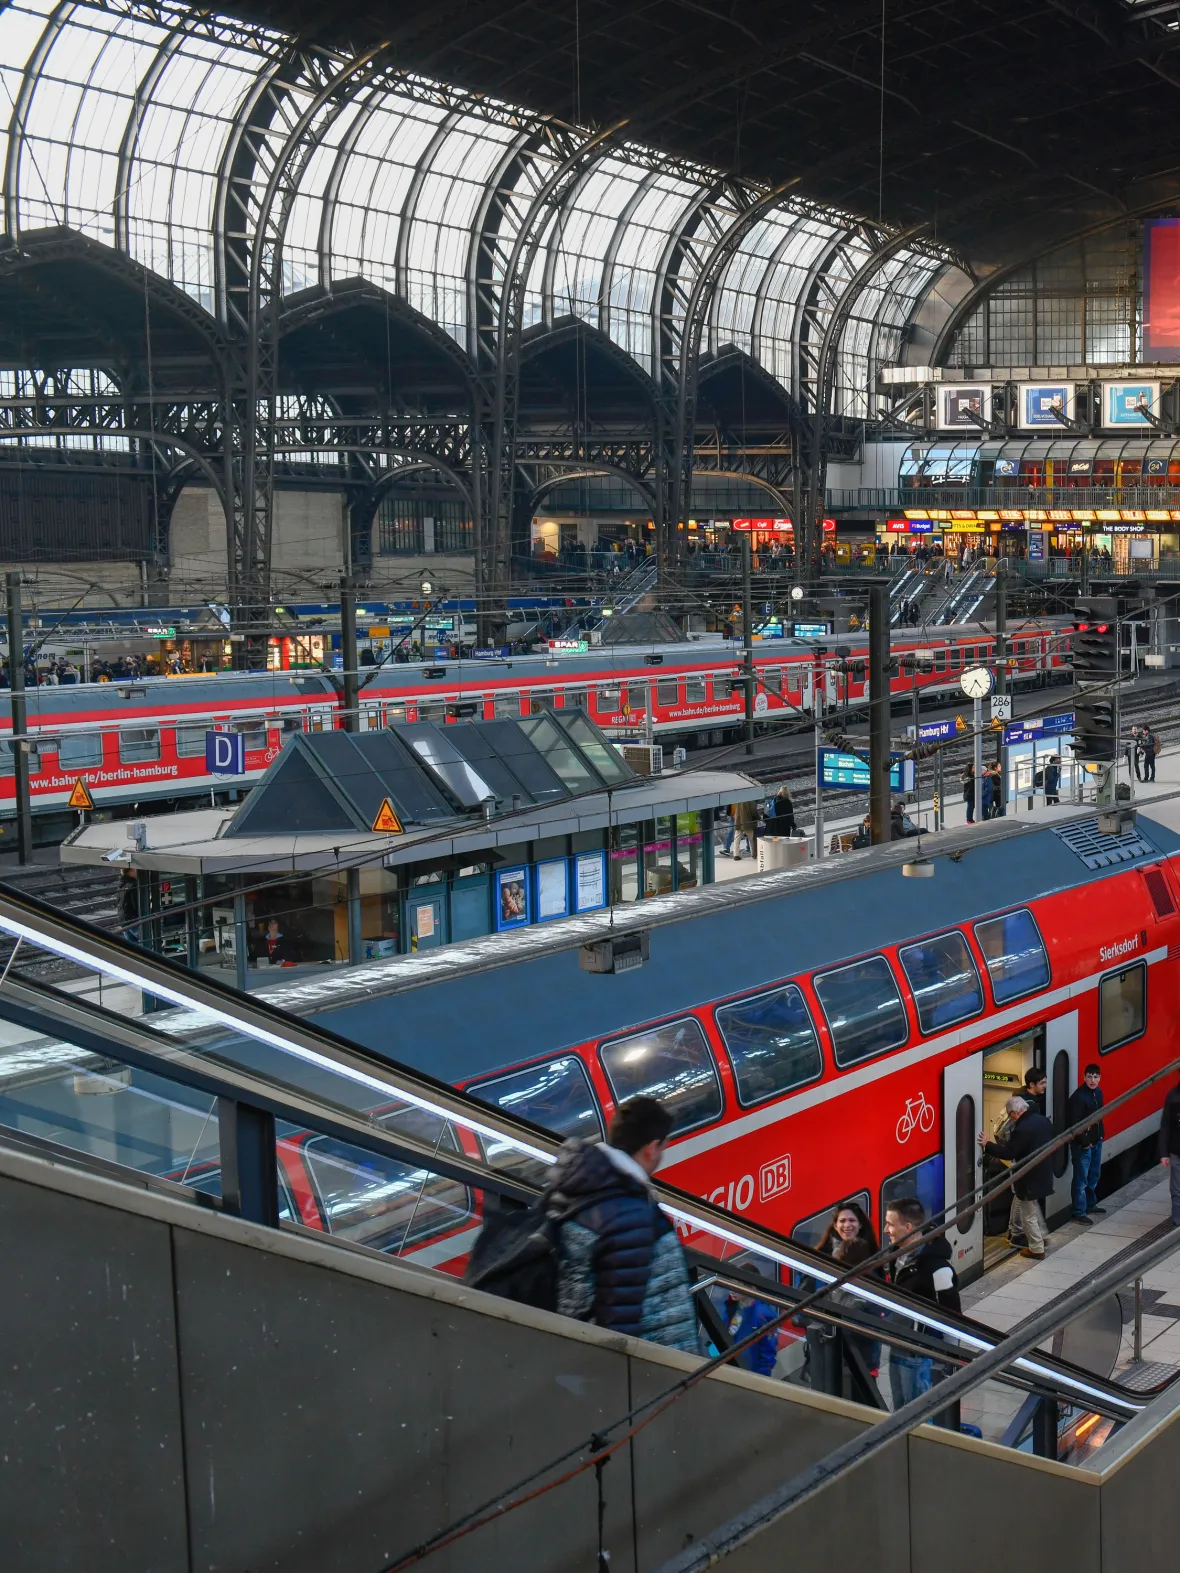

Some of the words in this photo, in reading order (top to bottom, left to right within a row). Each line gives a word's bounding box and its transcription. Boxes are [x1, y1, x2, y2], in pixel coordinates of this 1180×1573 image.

[993, 696, 1010, 707] 286
[669, 702, 740, 718] www.bahn.de/berlin-hamburg
[998, 707, 1004, 717] 6
[919, 727, 939, 739] Hamburg
[940, 725, 949, 734] Hbf
[216, 736, 232, 766] D
[1100, 934, 1138, 962] Sierksdorf
[762, 1160, 788, 1197] DB
